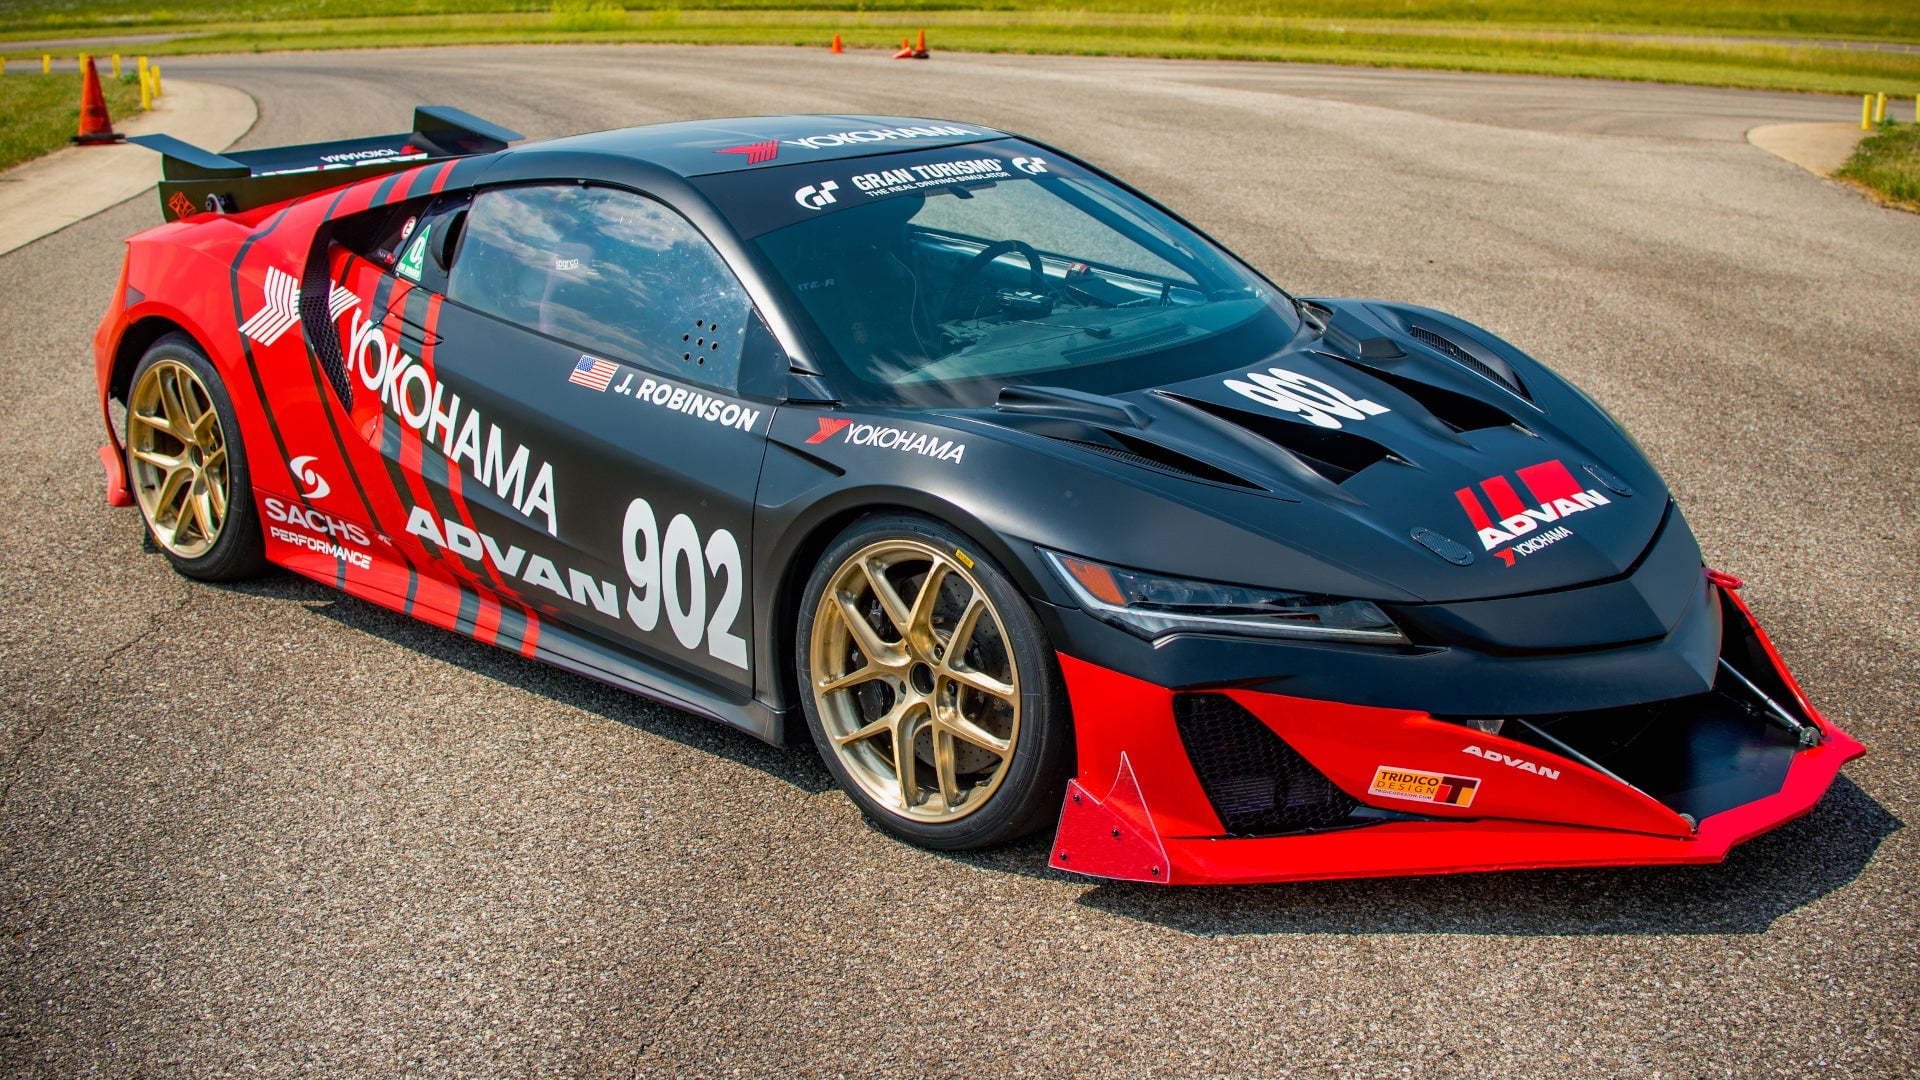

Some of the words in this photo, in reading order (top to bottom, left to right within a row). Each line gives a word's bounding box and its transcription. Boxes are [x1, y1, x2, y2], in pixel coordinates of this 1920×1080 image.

[320, 148, 400, 163] YOKOHAMA
[781, 126, 982, 150] YOKOHAMA
[851, 168, 916, 191] GRAN
[865, 188, 890, 198] THE
[890, 182, 918, 194] REAL
[915, 177, 957, 188] DRIVING
[955, 172, 1011, 183] SIMULATOR
[614, 373, 634, 396] J.
[635, 378, 760, 432] ROBINSON
[1223, 367, 1391, 430] 902
[347, 307, 558, 537] YOKOHAMA
[843, 423, 966, 464] YOKOHAMA
[264, 497, 371, 546] SACHS
[1476, 489, 1611, 551] ADVAN
[270, 526, 373, 570] PERFORMANCE
[1512, 525, 1573, 558] YOKOHAMA
[405, 506, 620, 619] ADVAN
[622, 497, 748, 670] 902
[1381, 771, 1440, 787] TRIDICO
[1462, 745, 1560, 780] ADVAN
[1376, 780, 1435, 795] DESIGN
